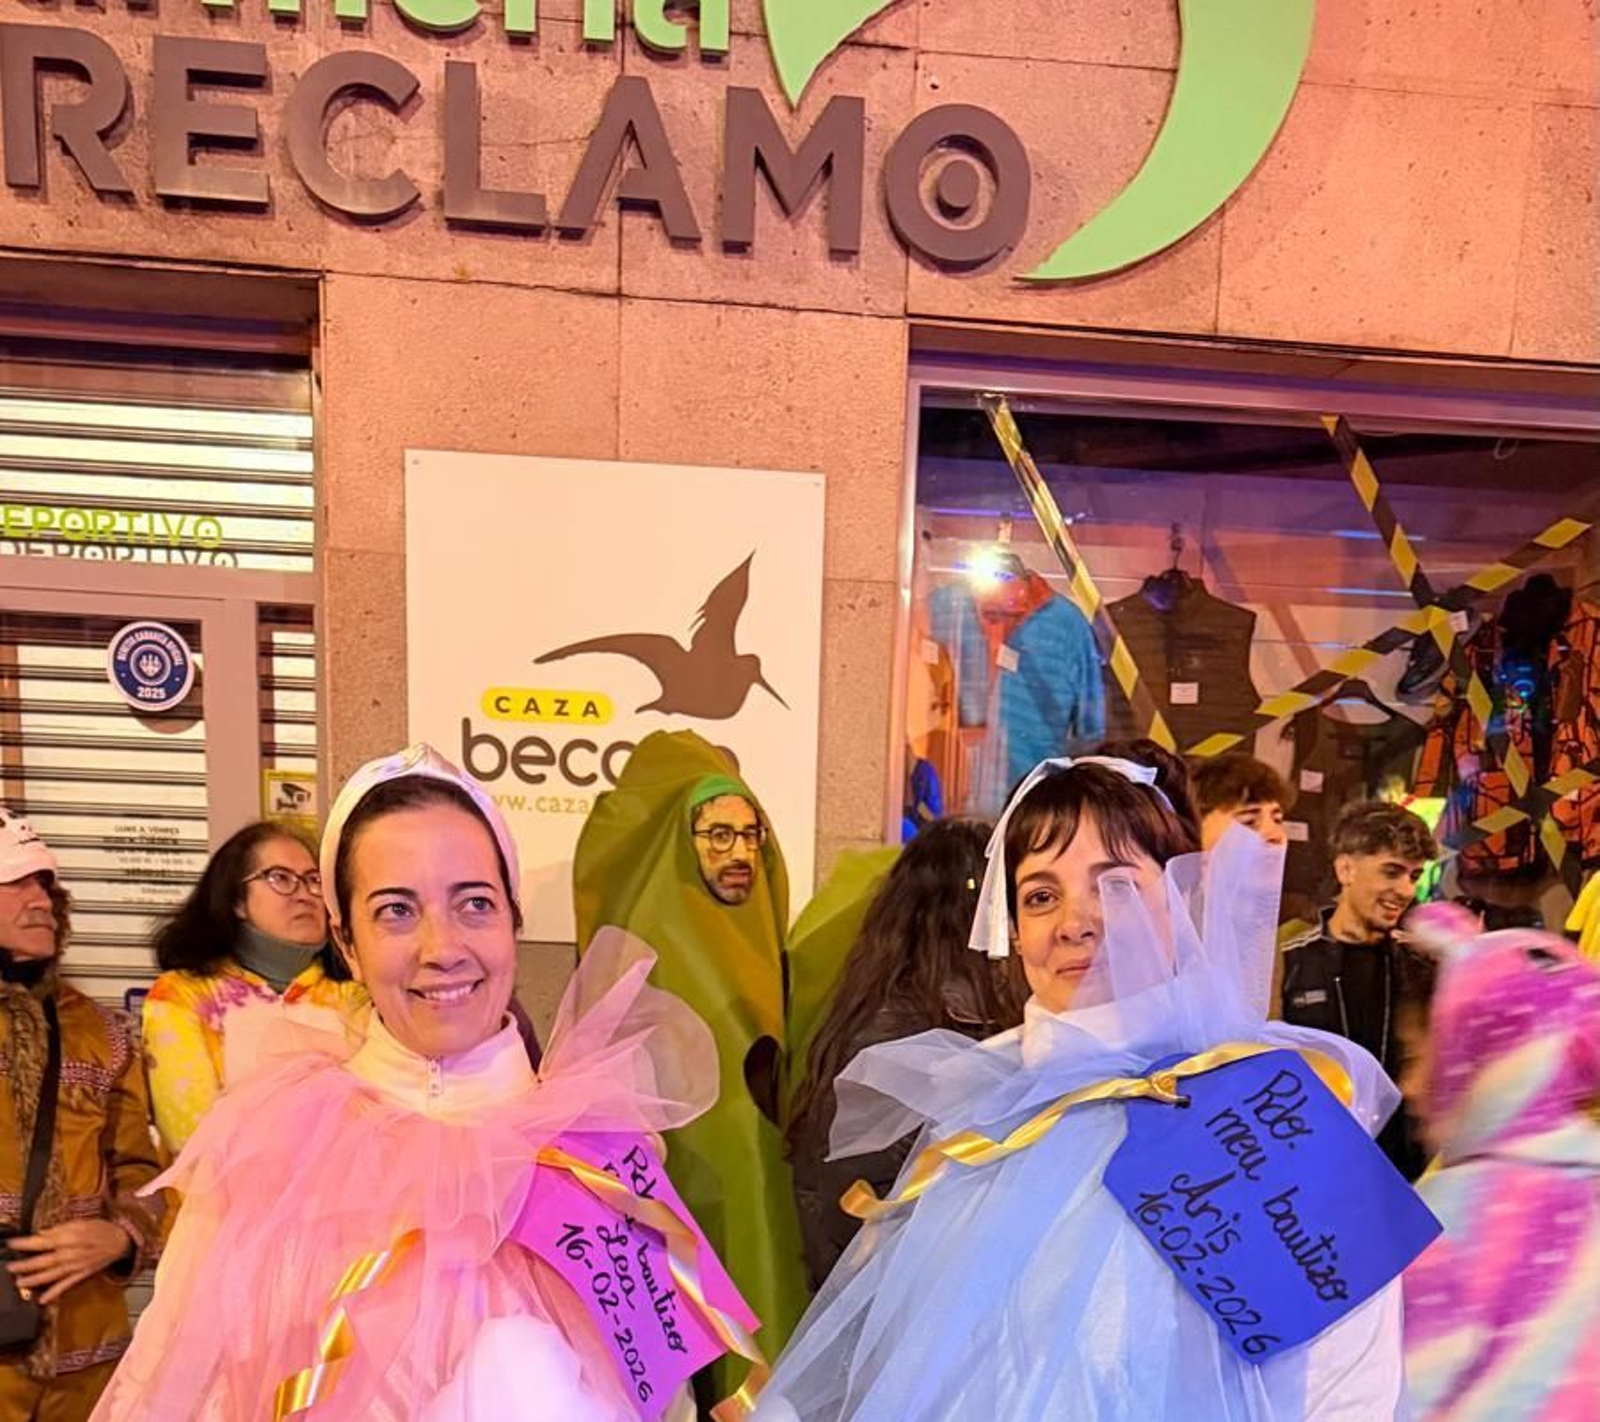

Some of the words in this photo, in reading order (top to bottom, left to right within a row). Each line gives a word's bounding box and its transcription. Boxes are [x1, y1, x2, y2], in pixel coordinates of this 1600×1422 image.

[1, 23, 1031, 262] RECLAMO
[137, 686, 166, 699] 2025
[494, 695, 600, 719] CAZA
[462, 716, 739, 788] bec
[622, 1144, 658, 1200] Rd
[1204, 1107, 1267, 1181] meu
[1262, 1186, 1349, 1302] bautizo
[555, 1222, 654, 1403] 16-02-2026
[635, 1241, 688, 1354] bautizo
